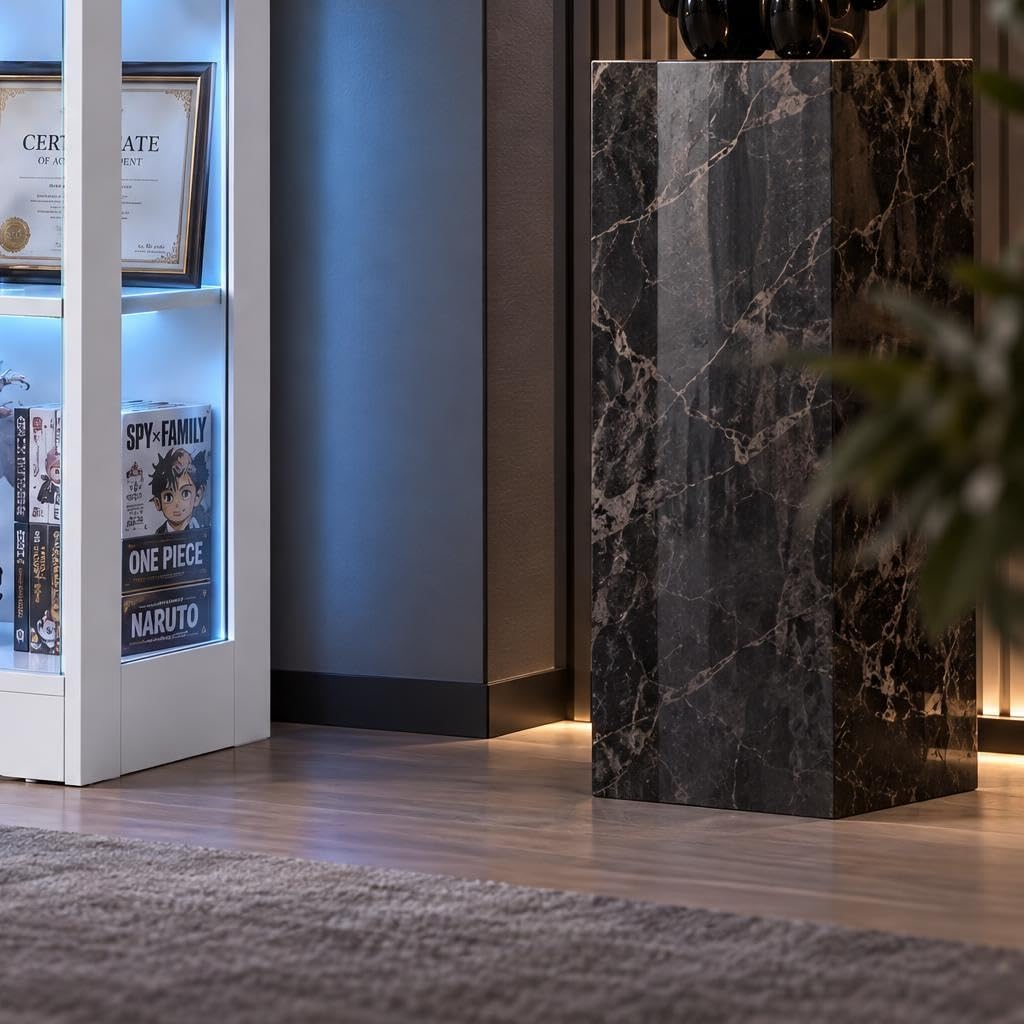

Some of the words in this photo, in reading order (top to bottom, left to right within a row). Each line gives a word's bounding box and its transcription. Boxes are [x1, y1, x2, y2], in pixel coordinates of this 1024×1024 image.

[37, 156, 50, 165] OF
[129, 547, 159, 575] ONE
[162, 541, 203, 570] PIECE
[131, 602, 199, 639] NARUTO
